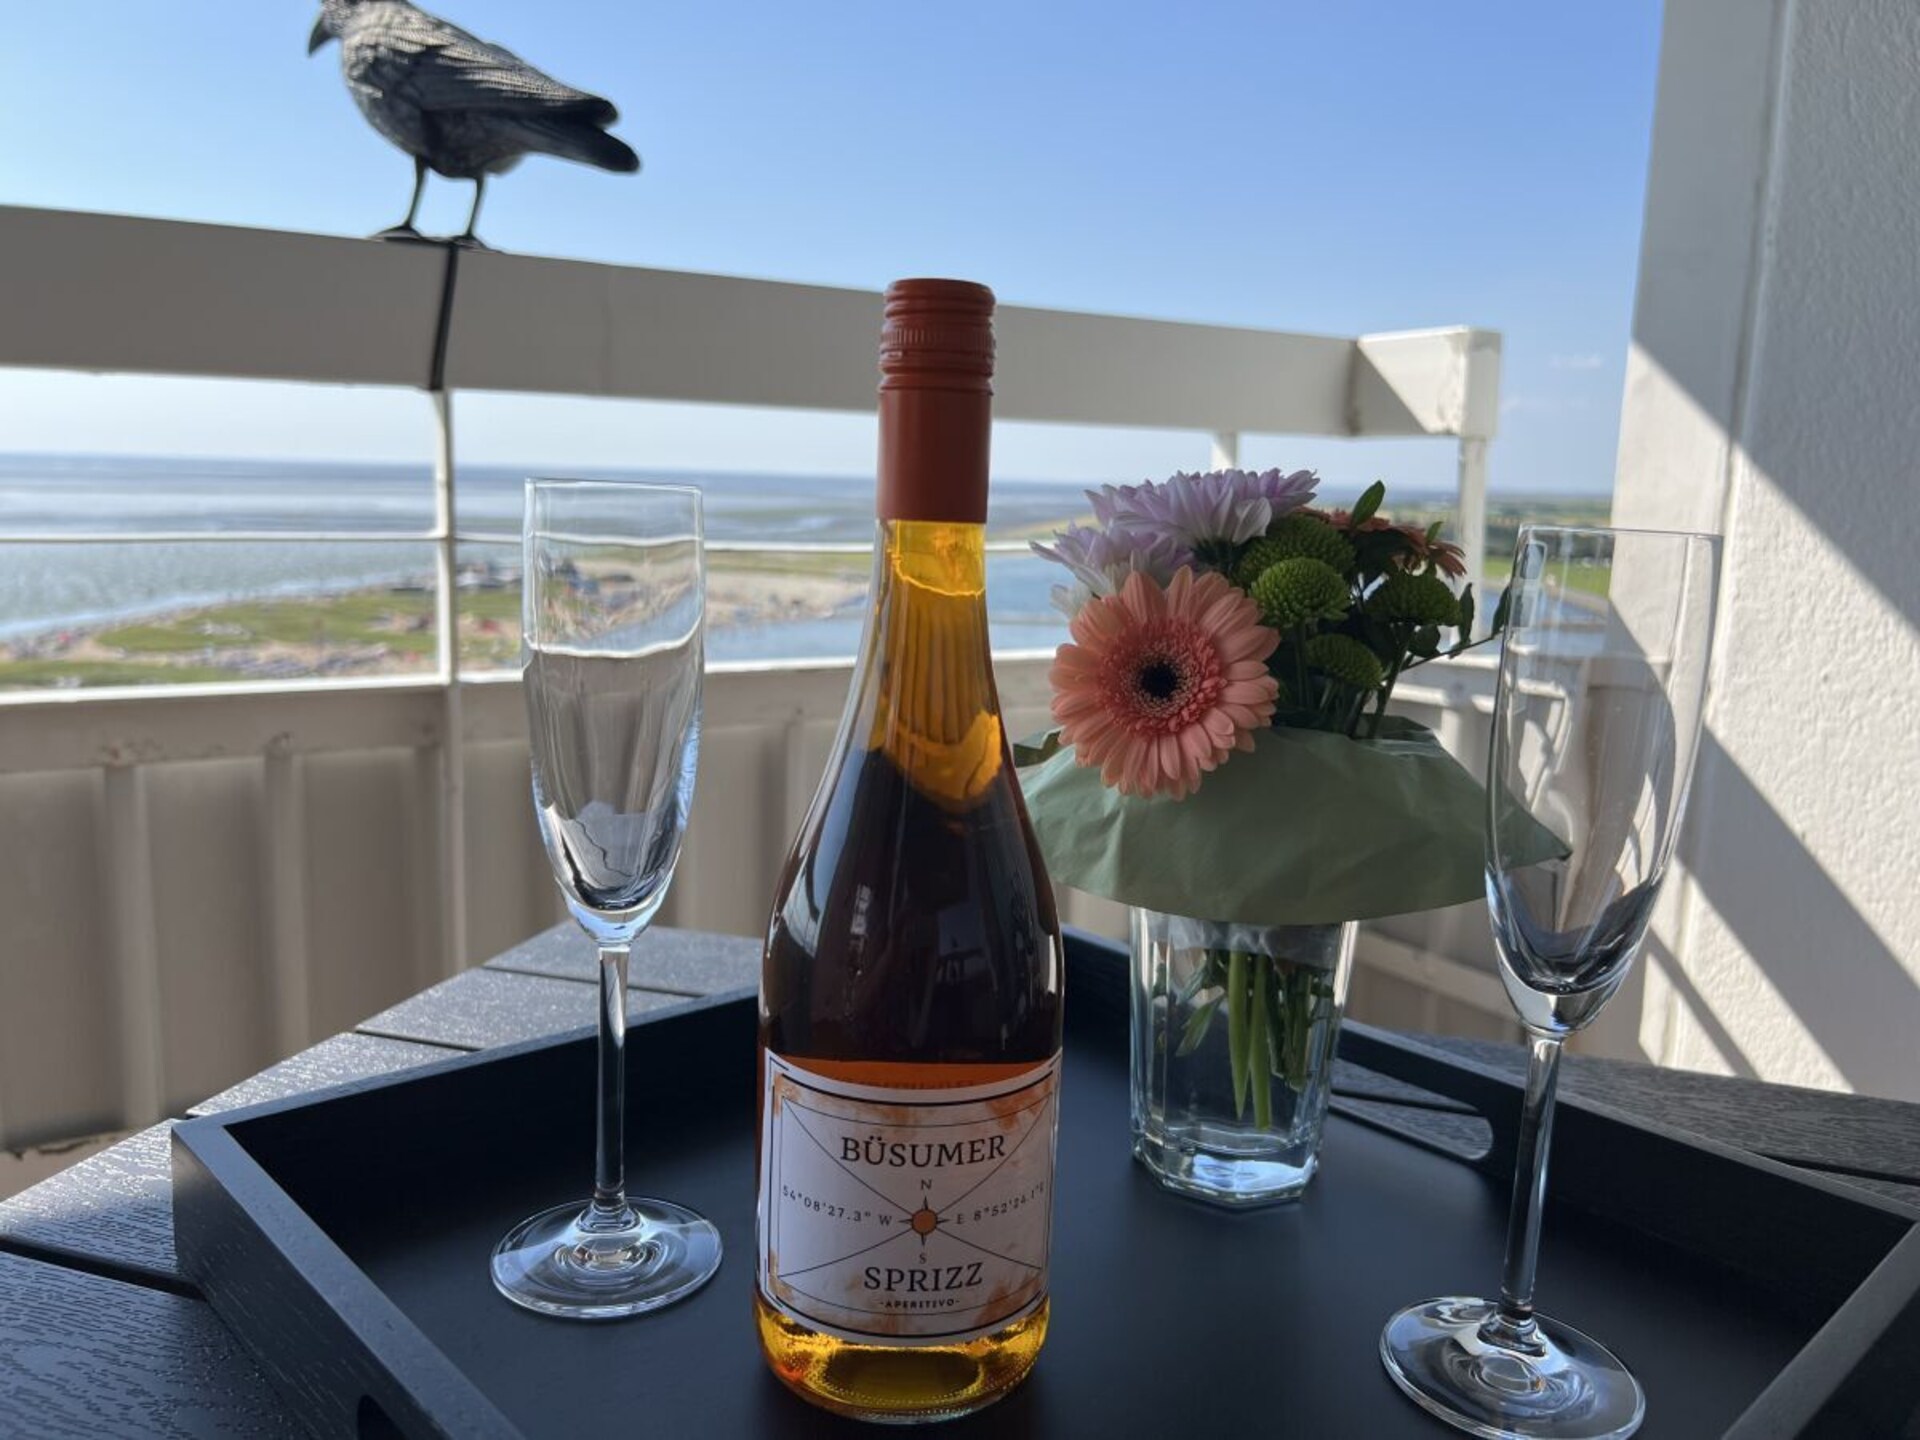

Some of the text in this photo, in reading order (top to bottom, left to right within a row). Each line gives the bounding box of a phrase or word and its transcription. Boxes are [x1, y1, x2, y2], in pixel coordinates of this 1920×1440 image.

[841, 1135, 1005, 1167] BÜSUMER
[920, 1179, 932, 1190] N
[879, 1215, 892, 1226] W
[957, 1214, 966, 1225] E
[919, 1252, 927, 1264] S
[864, 1262, 983, 1292] SPRIZZ
